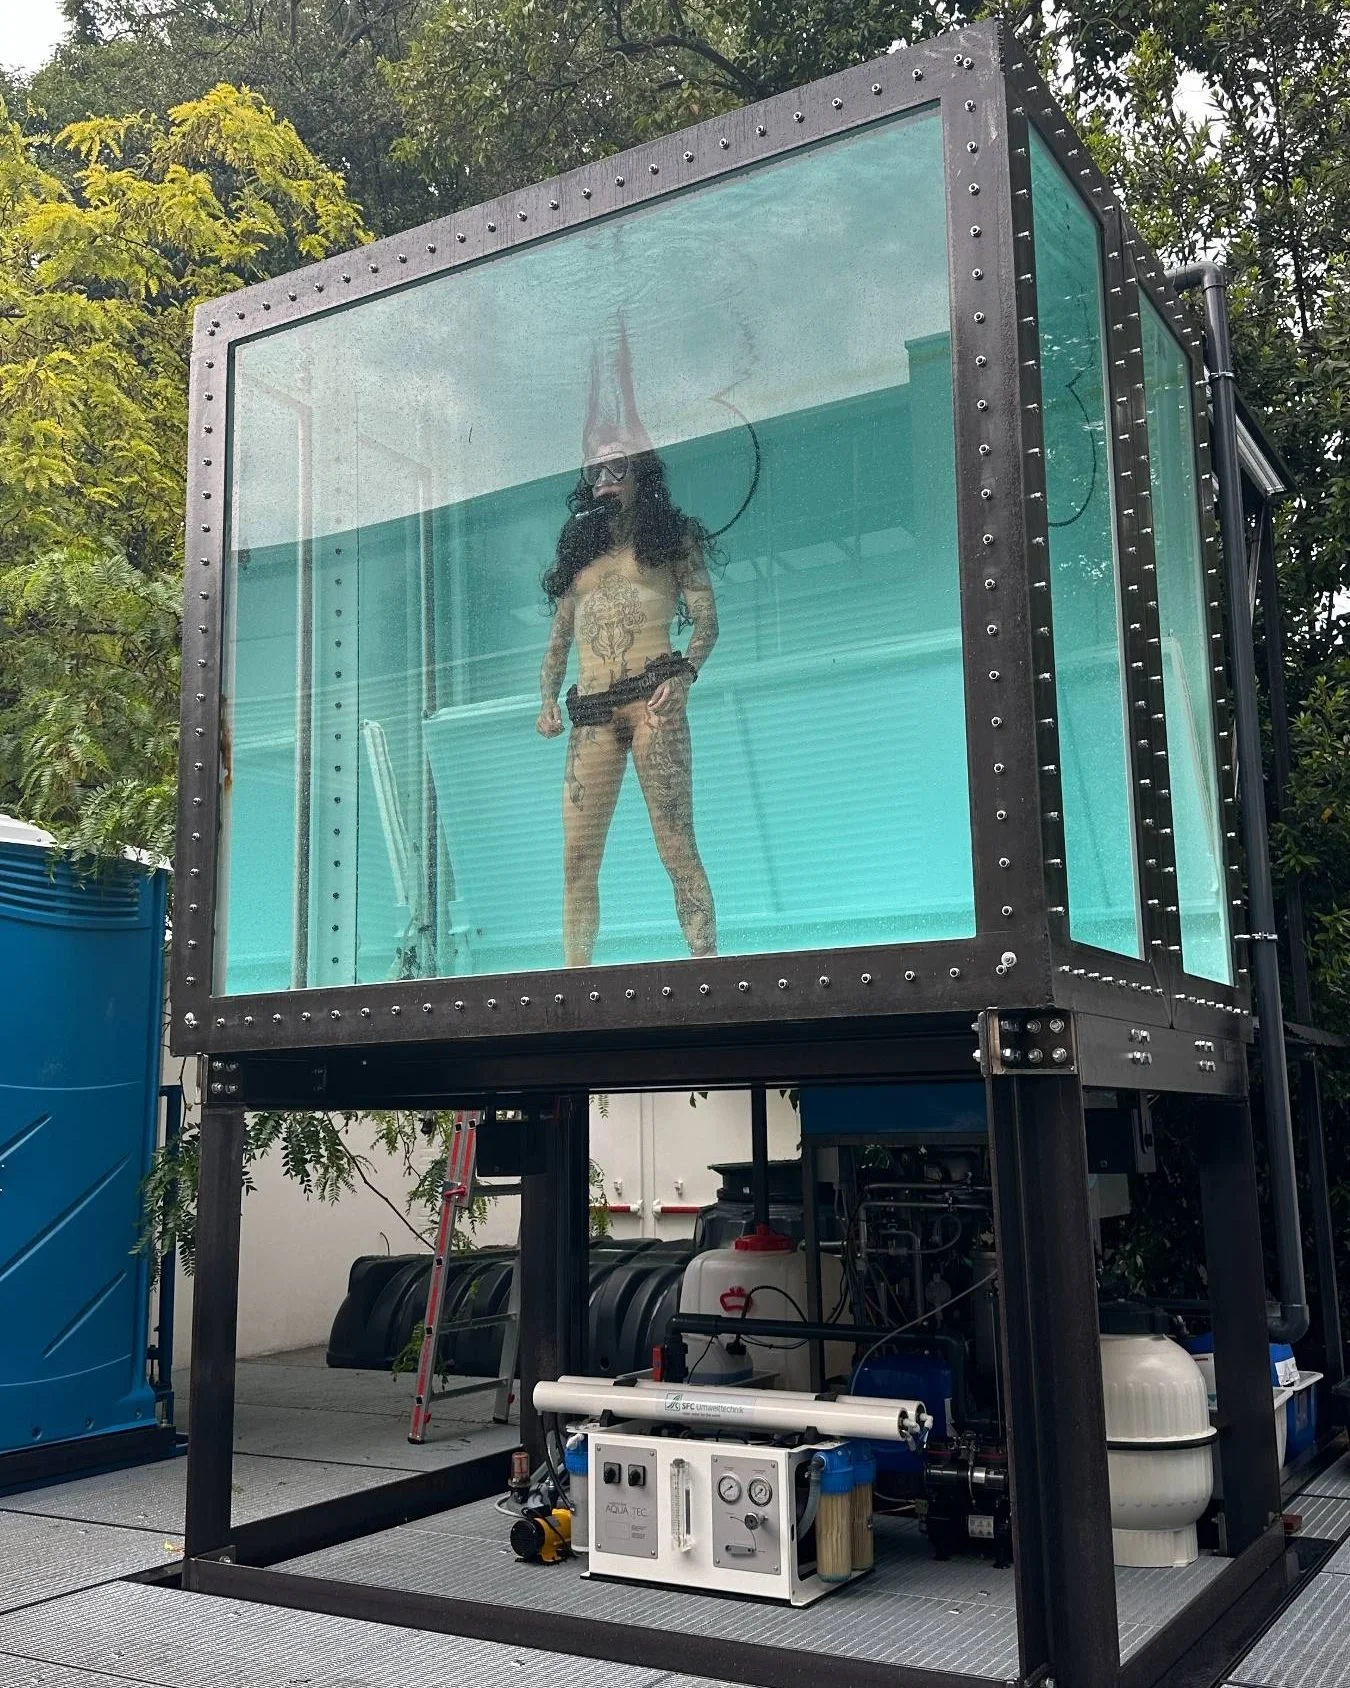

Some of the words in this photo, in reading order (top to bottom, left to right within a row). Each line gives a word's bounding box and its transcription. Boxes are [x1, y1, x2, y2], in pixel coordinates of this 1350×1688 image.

[681, 1402, 695, 1410] SFC
[696, 1404, 745, 1414] Umwelttechnik
[605, 1503, 629, 1515] AQUA
[632, 1506, 648, 1517] TEC
